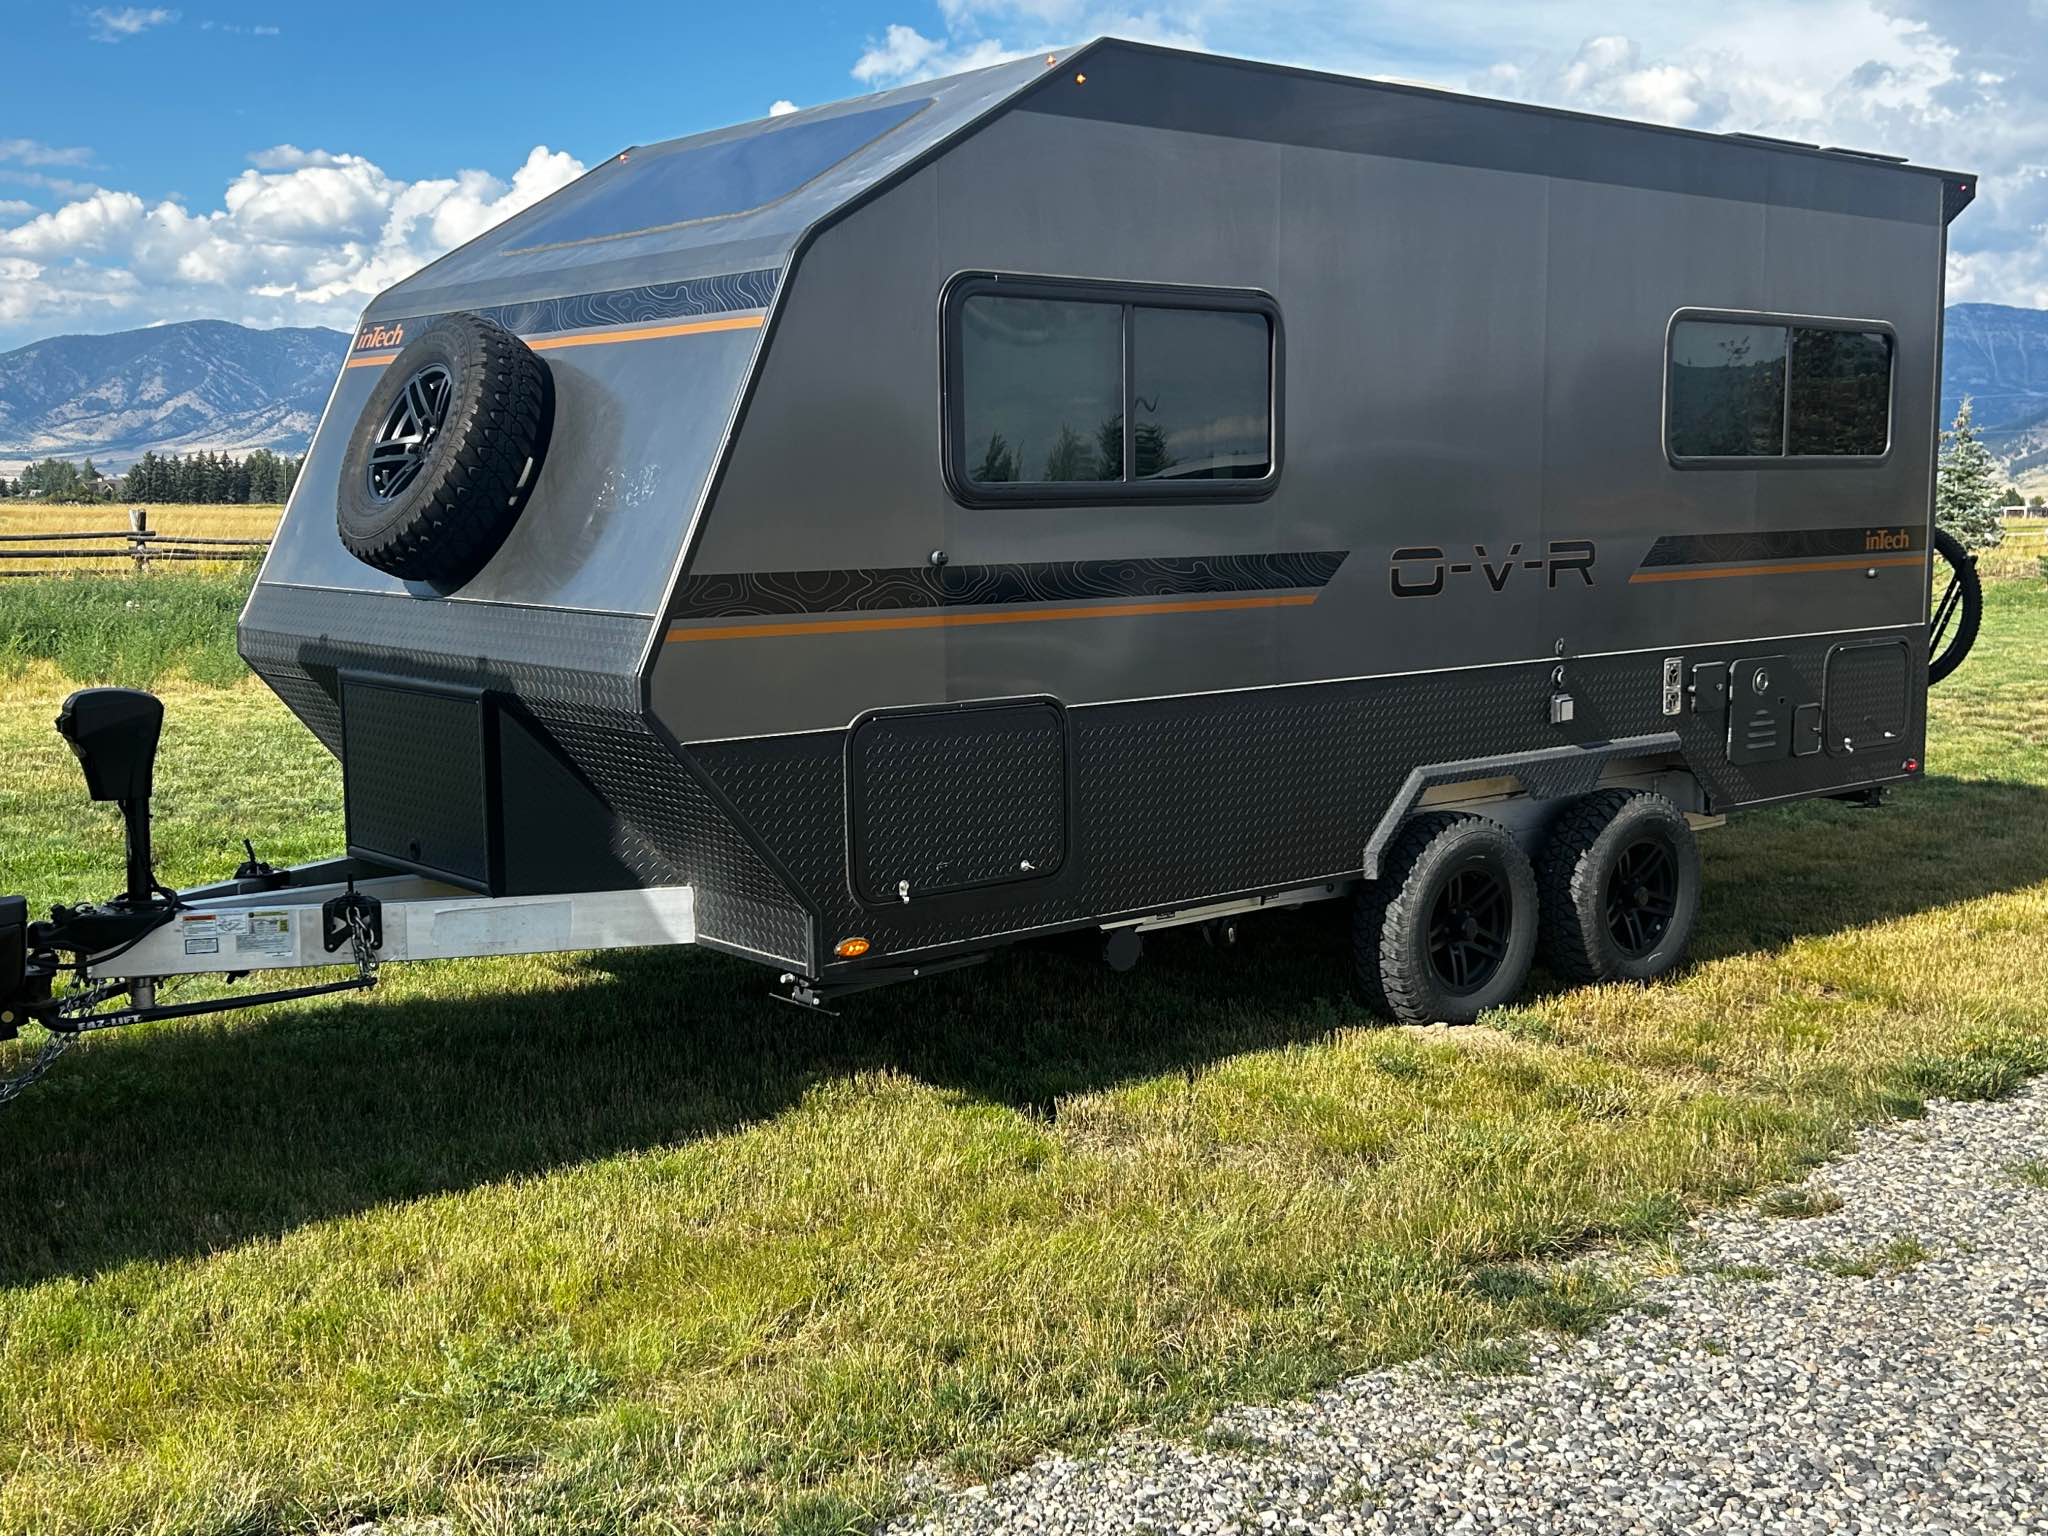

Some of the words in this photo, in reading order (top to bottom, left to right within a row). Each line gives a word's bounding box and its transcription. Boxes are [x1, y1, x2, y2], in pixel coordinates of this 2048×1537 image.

[356, 323, 404, 349] inTech
[1864, 528, 1910, 551] inTech
[1389, 538, 1597, 599] O-V-R
[77, 1014, 141, 1031] EAZ-LIFT
